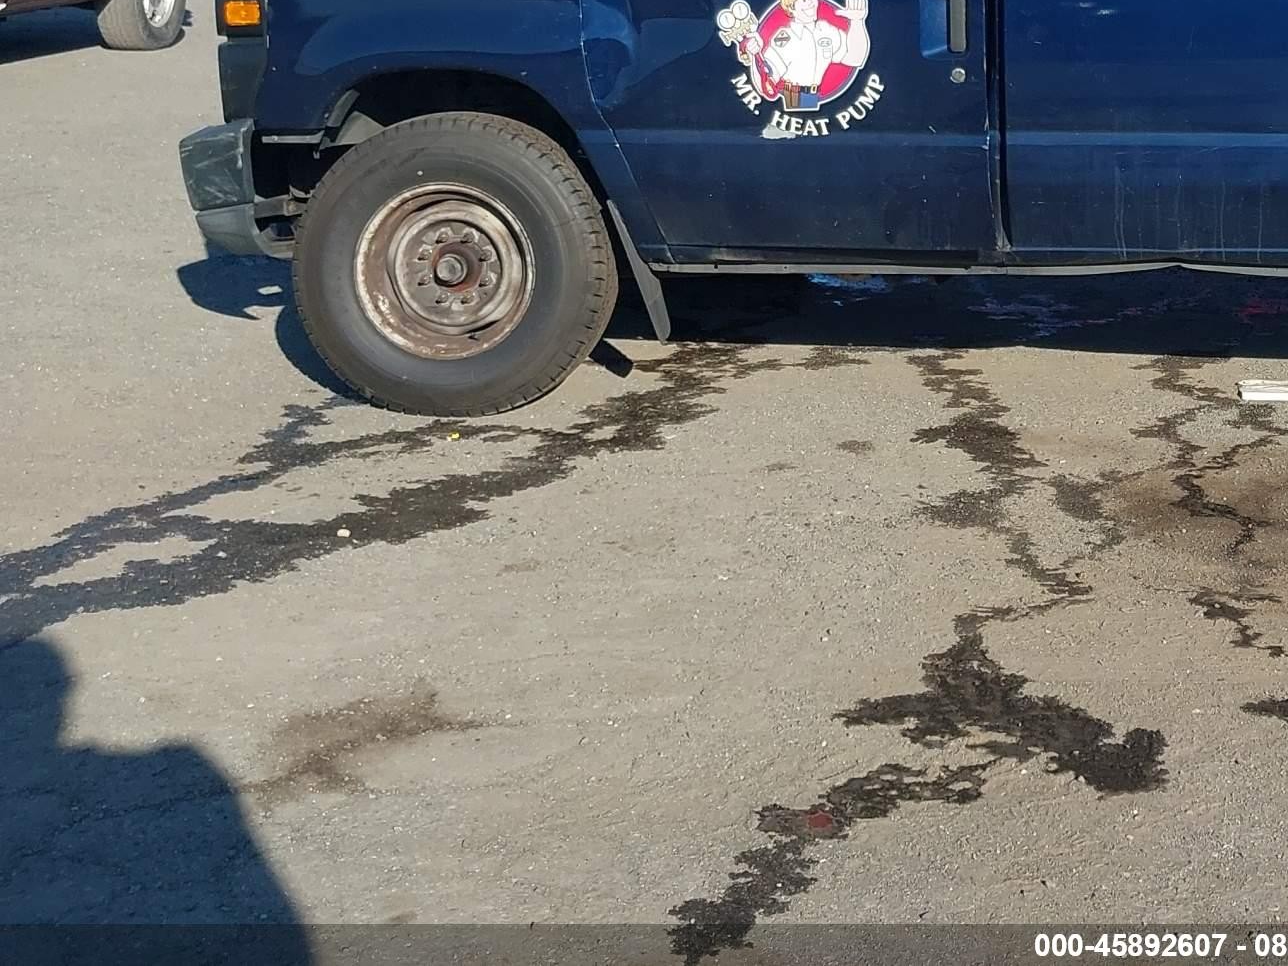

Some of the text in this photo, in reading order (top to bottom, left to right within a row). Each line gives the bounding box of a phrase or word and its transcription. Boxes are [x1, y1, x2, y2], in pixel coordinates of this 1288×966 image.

[731, 73, 887, 137] MR. HEAT PUMP
